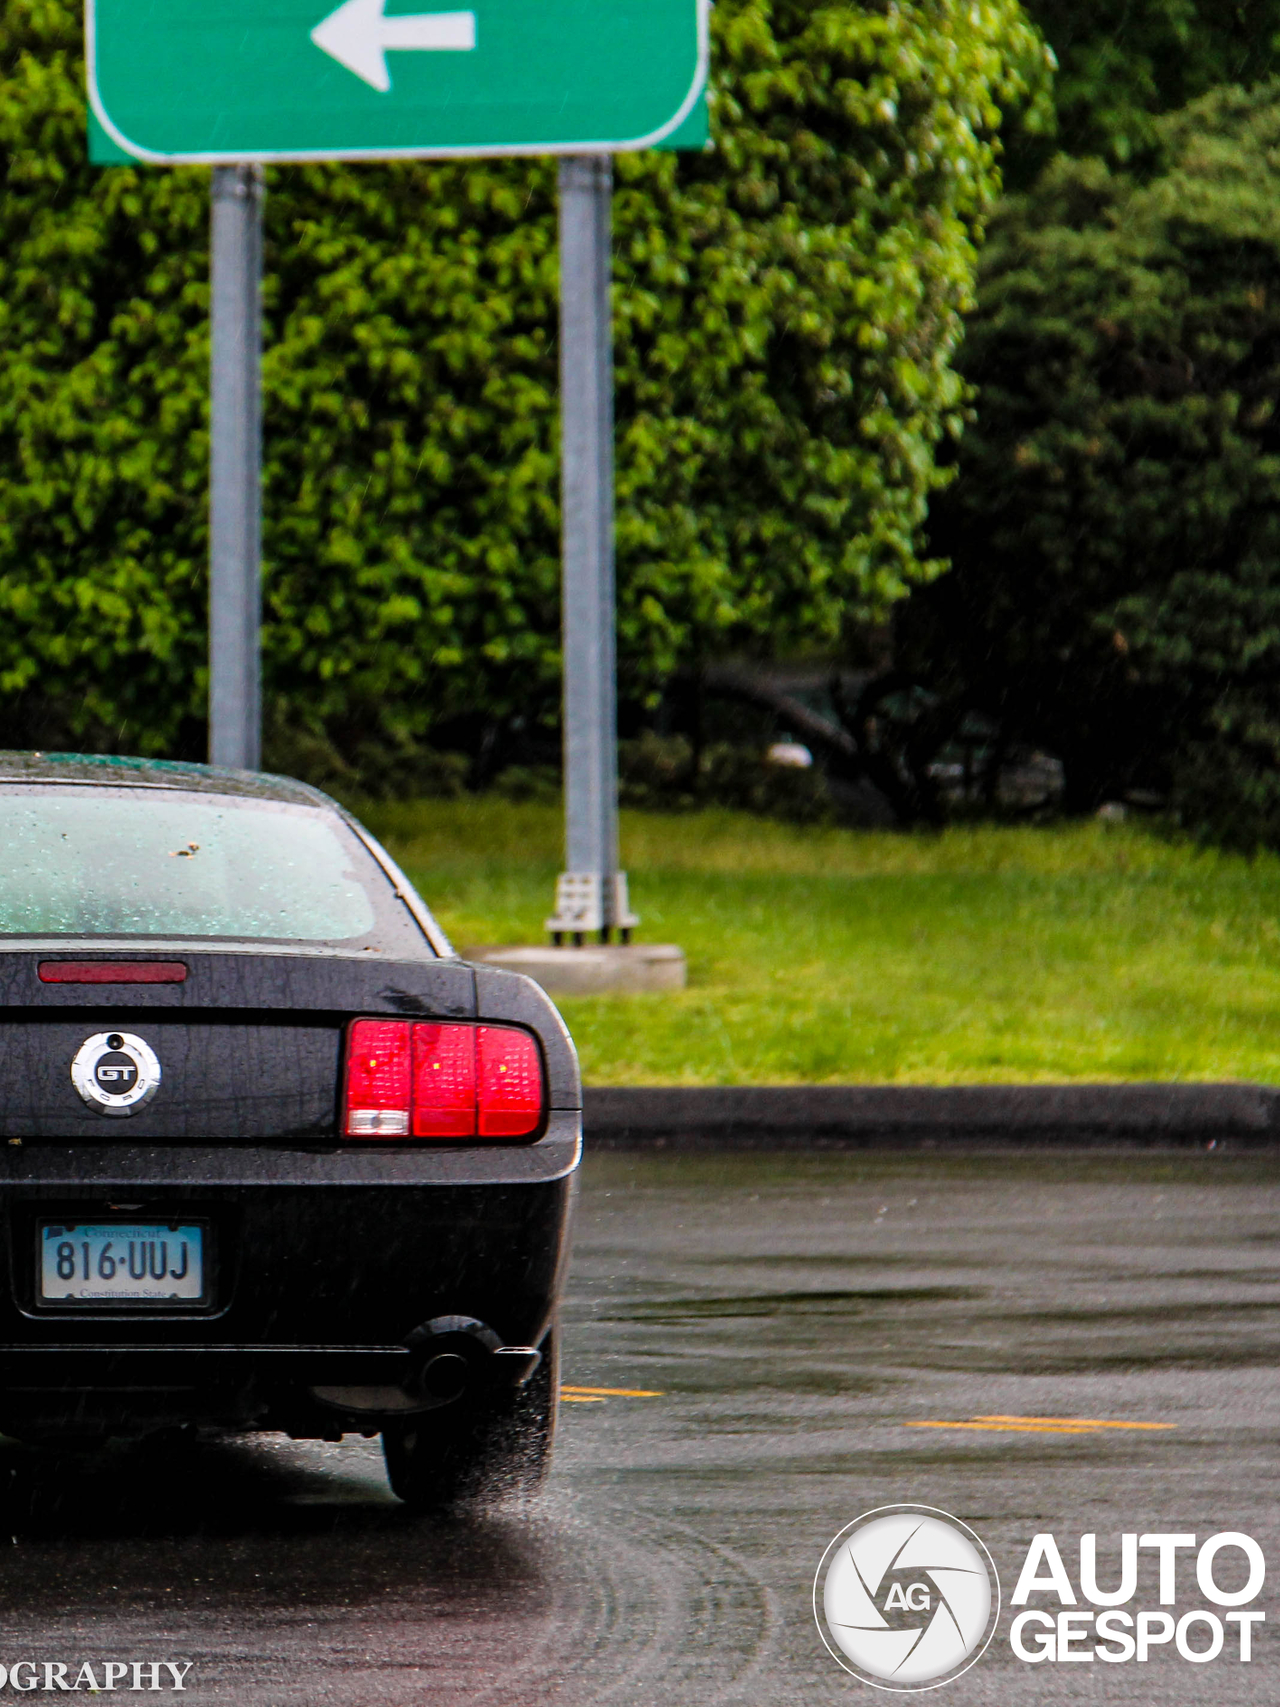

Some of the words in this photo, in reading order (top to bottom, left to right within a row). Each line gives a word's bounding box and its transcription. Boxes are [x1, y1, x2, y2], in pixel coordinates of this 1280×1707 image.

[97, 1066, 136, 1081] GT
[80, 1288, 140, 1298] Constitution
[143, 1289, 167, 1298] State
